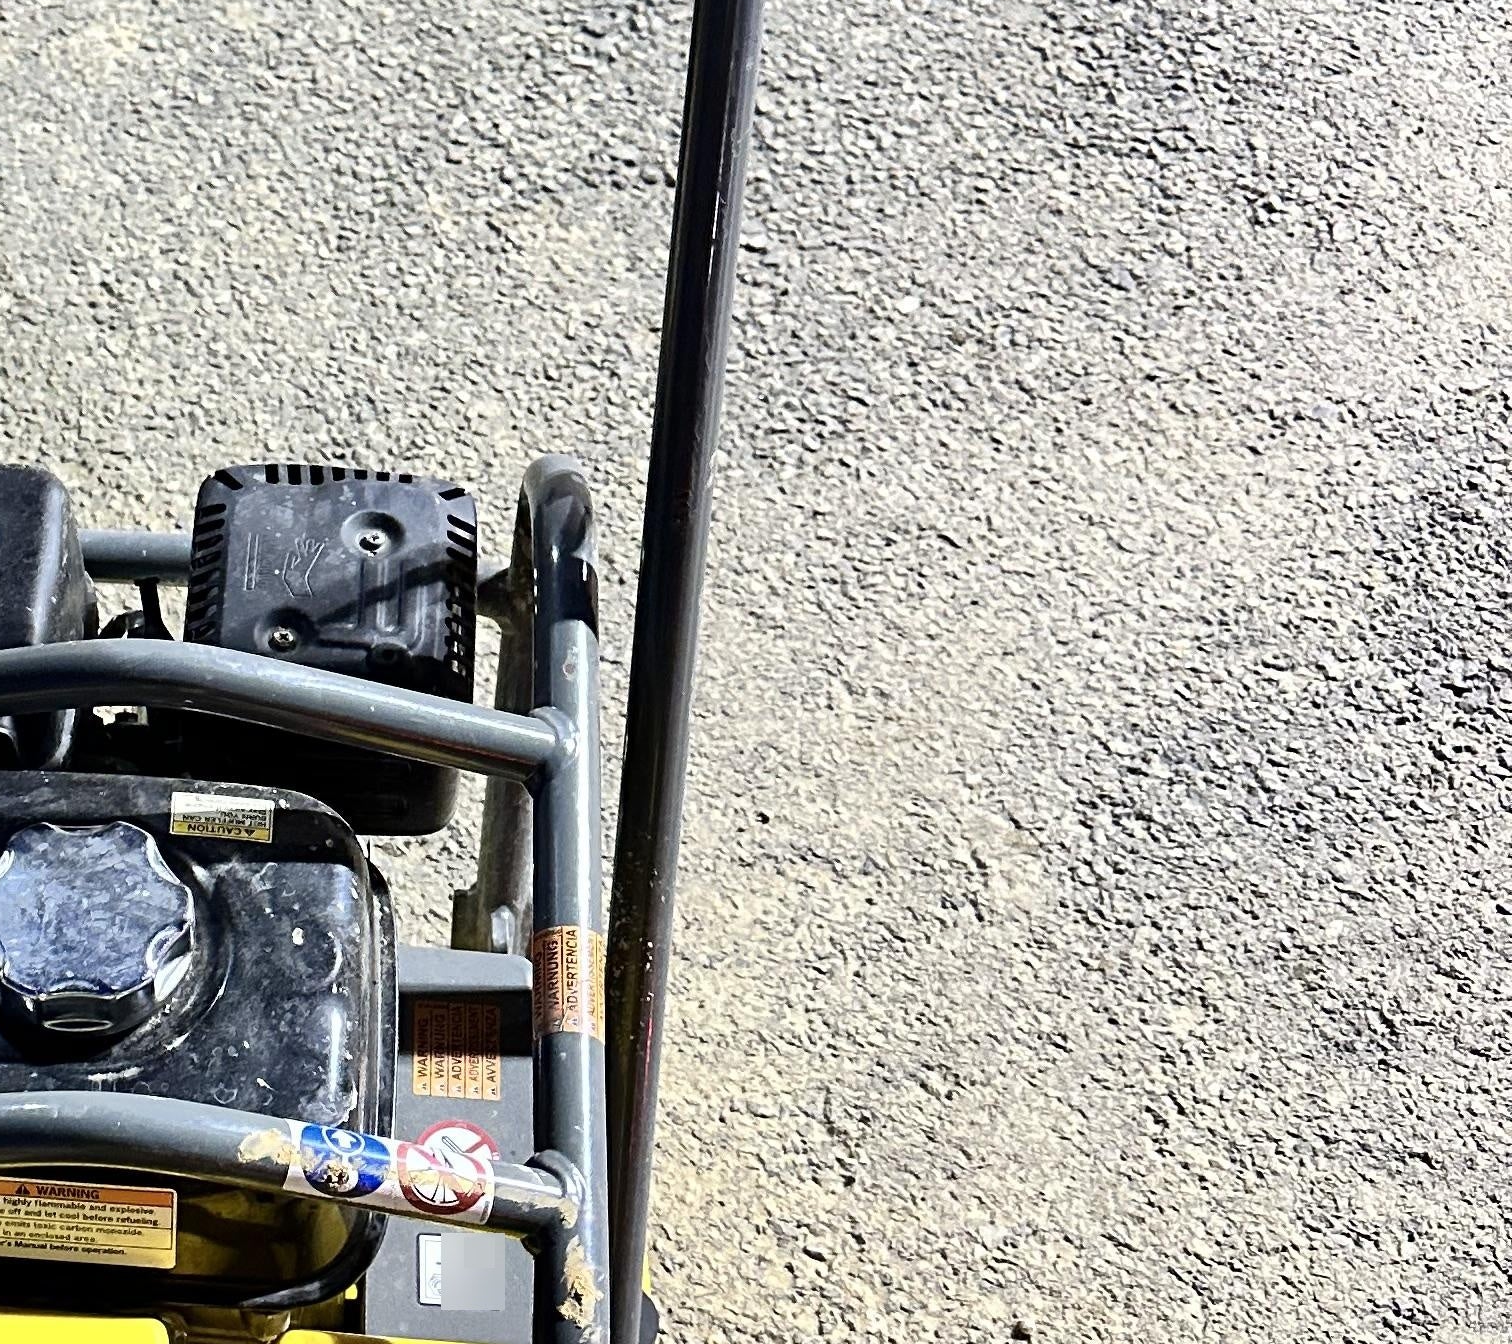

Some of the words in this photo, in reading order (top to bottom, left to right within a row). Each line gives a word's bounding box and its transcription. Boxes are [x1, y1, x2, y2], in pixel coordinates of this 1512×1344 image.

[182, 814, 202, 822] CAN
[187, 823, 242, 836] CAUTION
[565, 929, 577, 1012] ADVERTENCIA
[417, 1016, 428, 1078] WARNING
[35, 1184, 100, 1201] WARNING
[4, 1196, 32, 1207] highly
[35, 1199, 87, 1210] flammable
[24, 1209, 42, 1217] and
[45, 1210, 57, 1218] let
[59, 1212, 79, 1221] cool
[82, 1213, 114, 1223] before
[34, 1222, 57, 1230] toxic
[59, 1224, 94, 1233] carbon
[28, 1232, 71, 1241] enclosed
[14, 1241, 48, 1249] Manual
[49, 1243, 80, 1252] before
